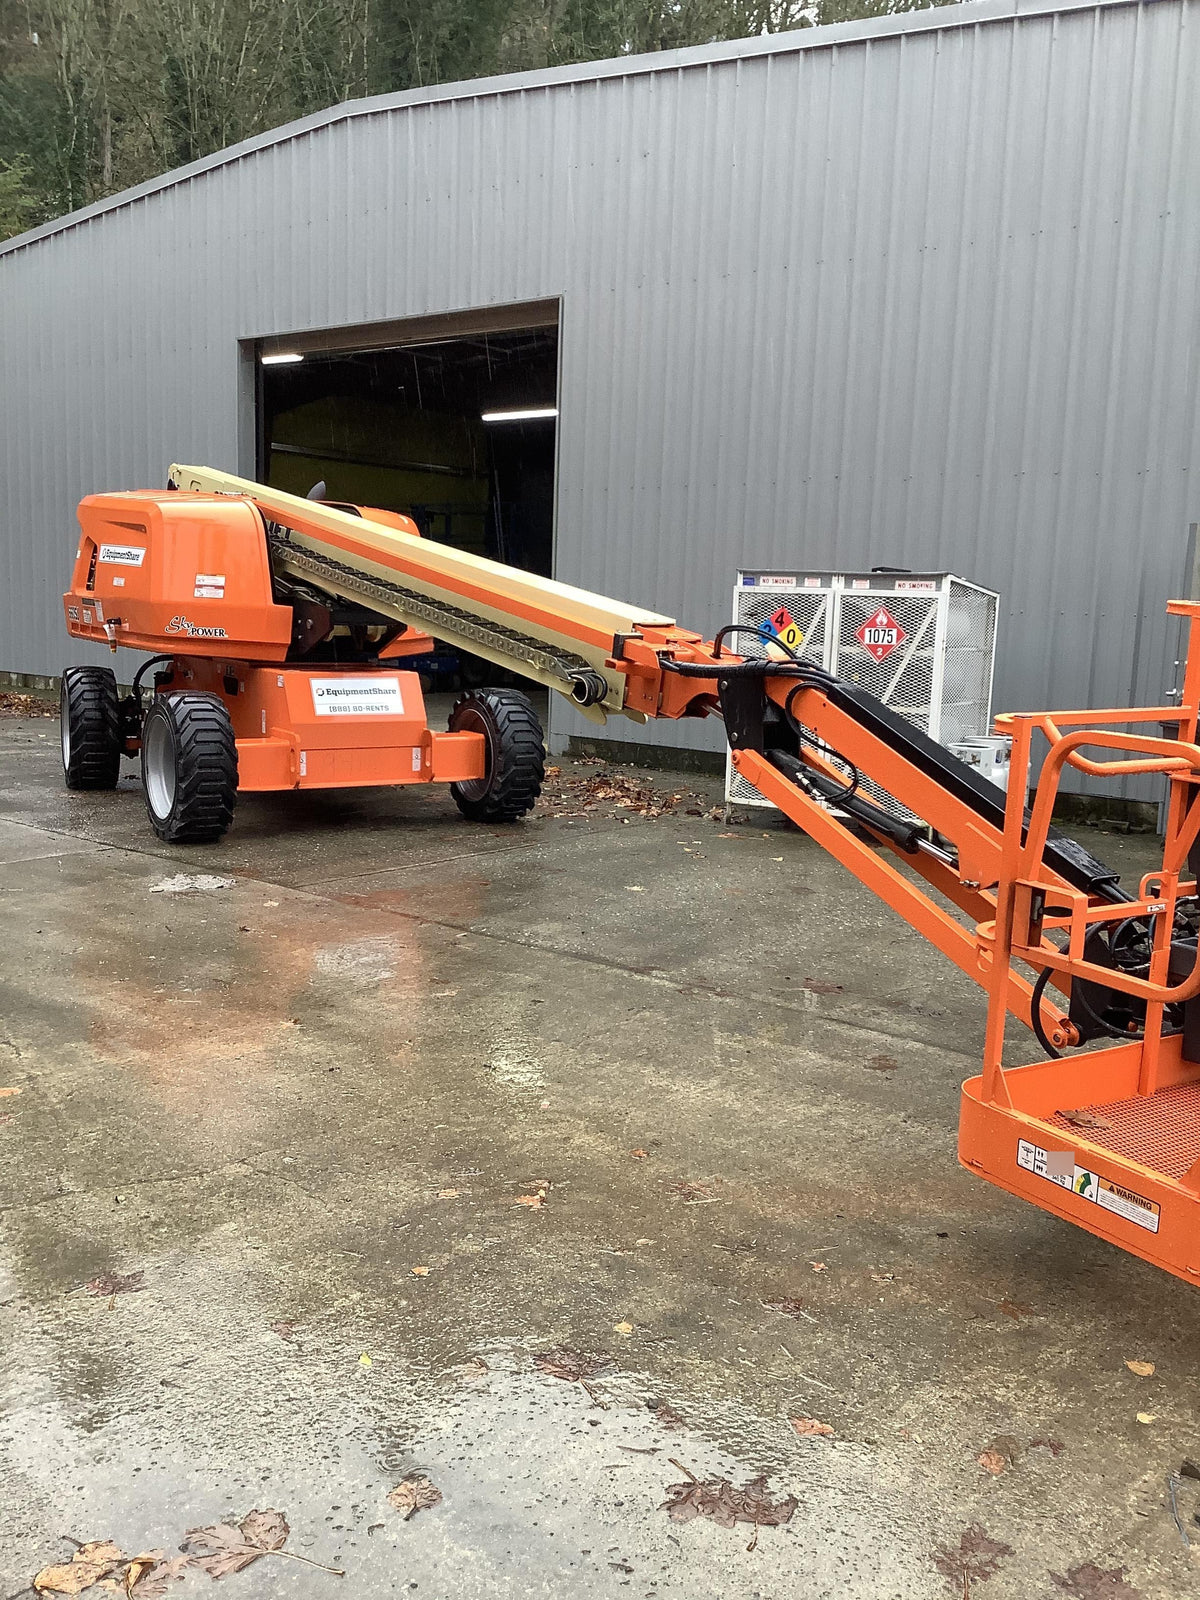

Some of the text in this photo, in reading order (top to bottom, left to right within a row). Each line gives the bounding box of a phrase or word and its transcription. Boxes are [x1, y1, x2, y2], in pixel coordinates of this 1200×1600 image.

[165, 616, 225, 637] Sky POWER
[774, 611, 785, 627] 4
[786, 628, 796, 644] 0
[868, 628, 893, 644] 1075
[876, 647, 883, 656] 2
[325, 687, 397, 696] EquipmentShare
[1116, 1187, 1152, 1211] WARNING
